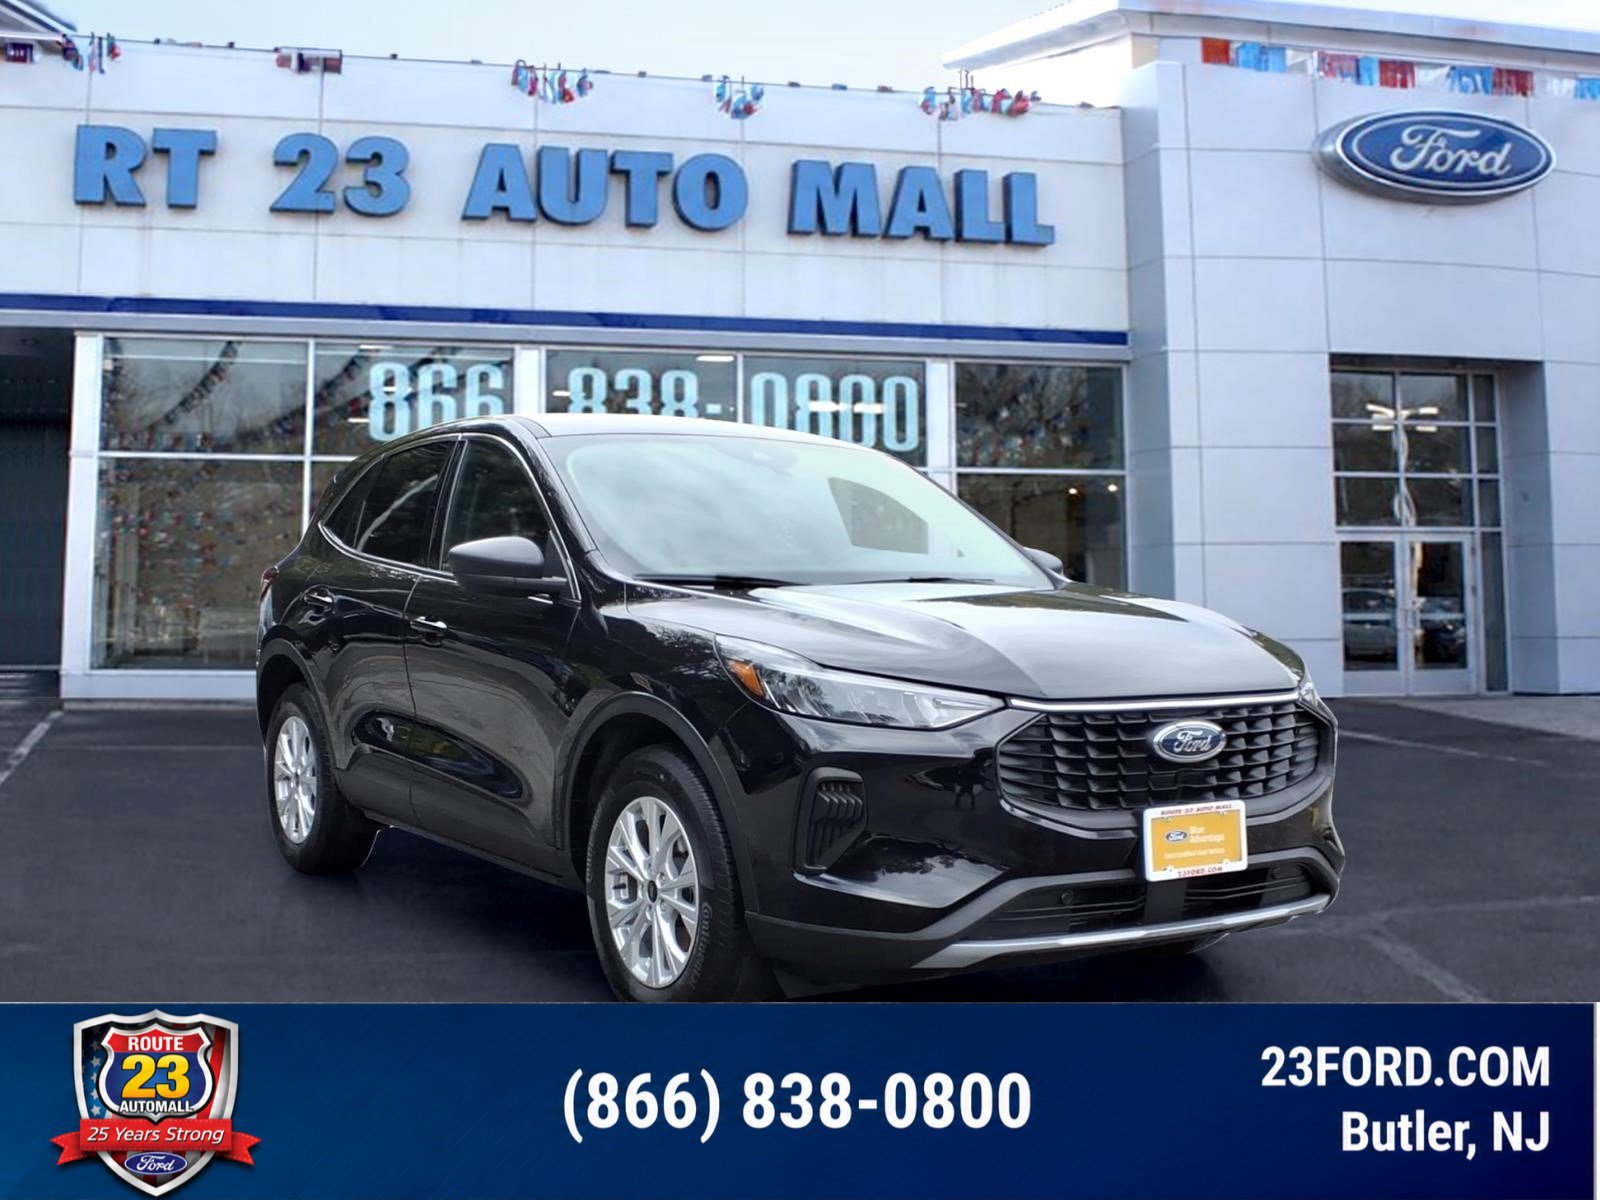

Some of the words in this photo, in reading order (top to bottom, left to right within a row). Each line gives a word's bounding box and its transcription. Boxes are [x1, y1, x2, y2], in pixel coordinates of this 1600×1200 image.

[1389, 124, 1513, 175] Ford
[74, 124, 218, 209] RT
[269, 132, 411, 218] 23
[461, 142, 749, 232] AUTO
[786, 159, 1056, 247] MALL
[369, 361, 506, 442] 866
[1173, 730, 1213, 753] Ford
